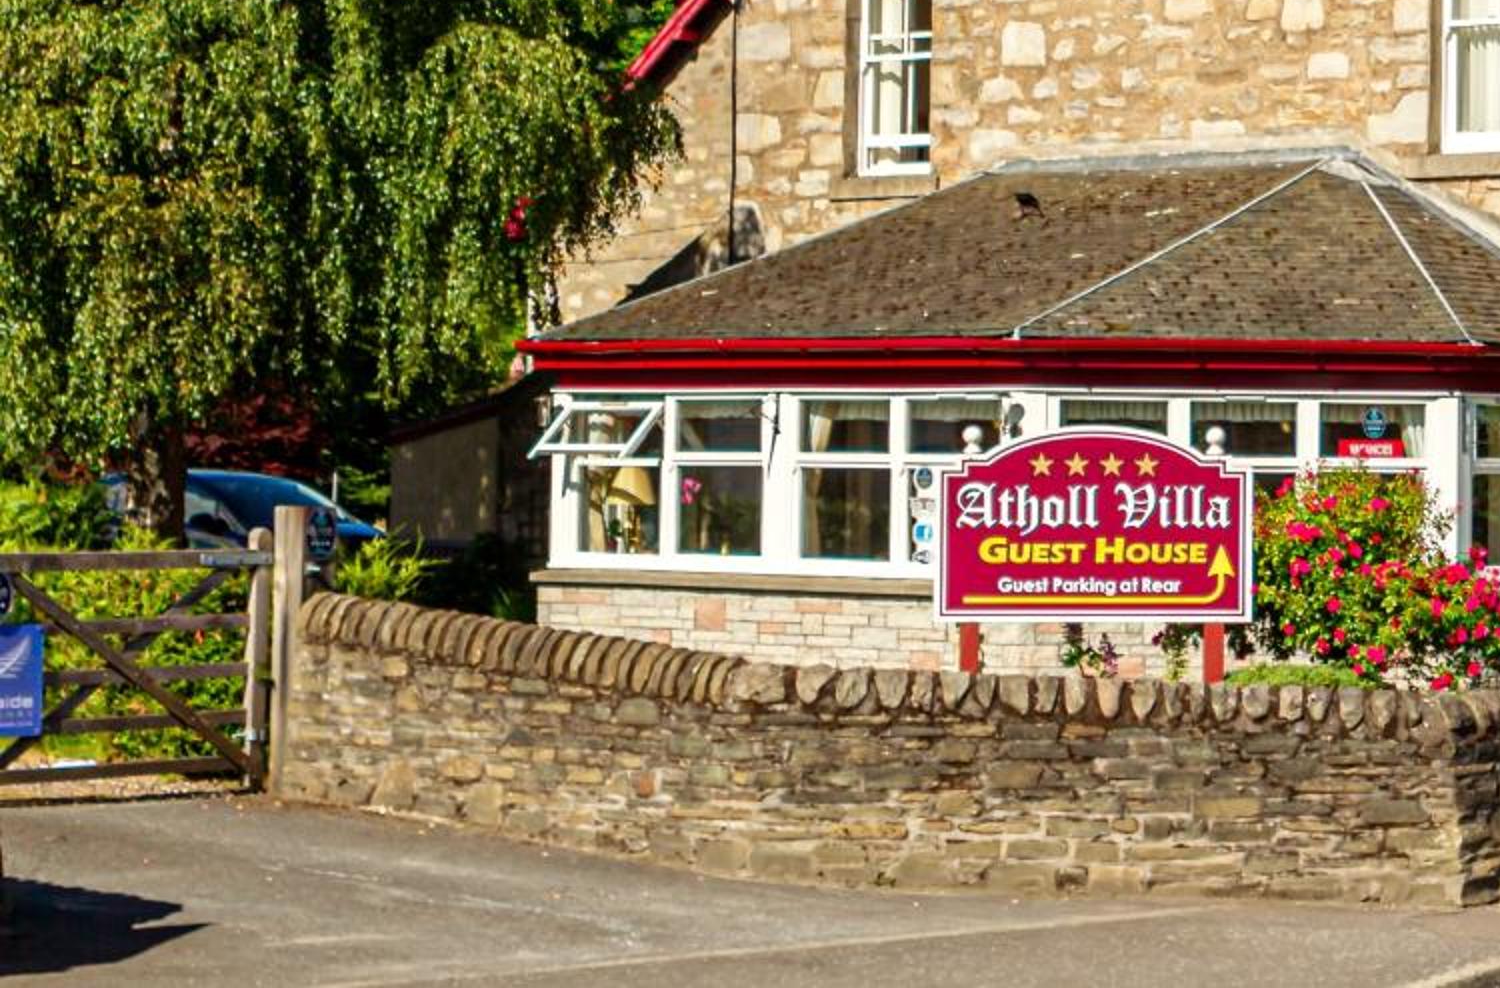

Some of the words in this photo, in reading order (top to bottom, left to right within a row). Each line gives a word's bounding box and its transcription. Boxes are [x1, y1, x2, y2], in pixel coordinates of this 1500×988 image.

[956, 482, 1099, 536] Atholl
[1114, 482, 1231, 528] Villa
[979, 537, 1086, 563] GUEST
[1095, 537, 1208, 563] HOUSE
[997, 576, 1048, 593] Guest
[1053, 576, 1116, 596] Parking
[1119, 577, 1138, 593] at
[1141, 577, 1181, 593] Rear
